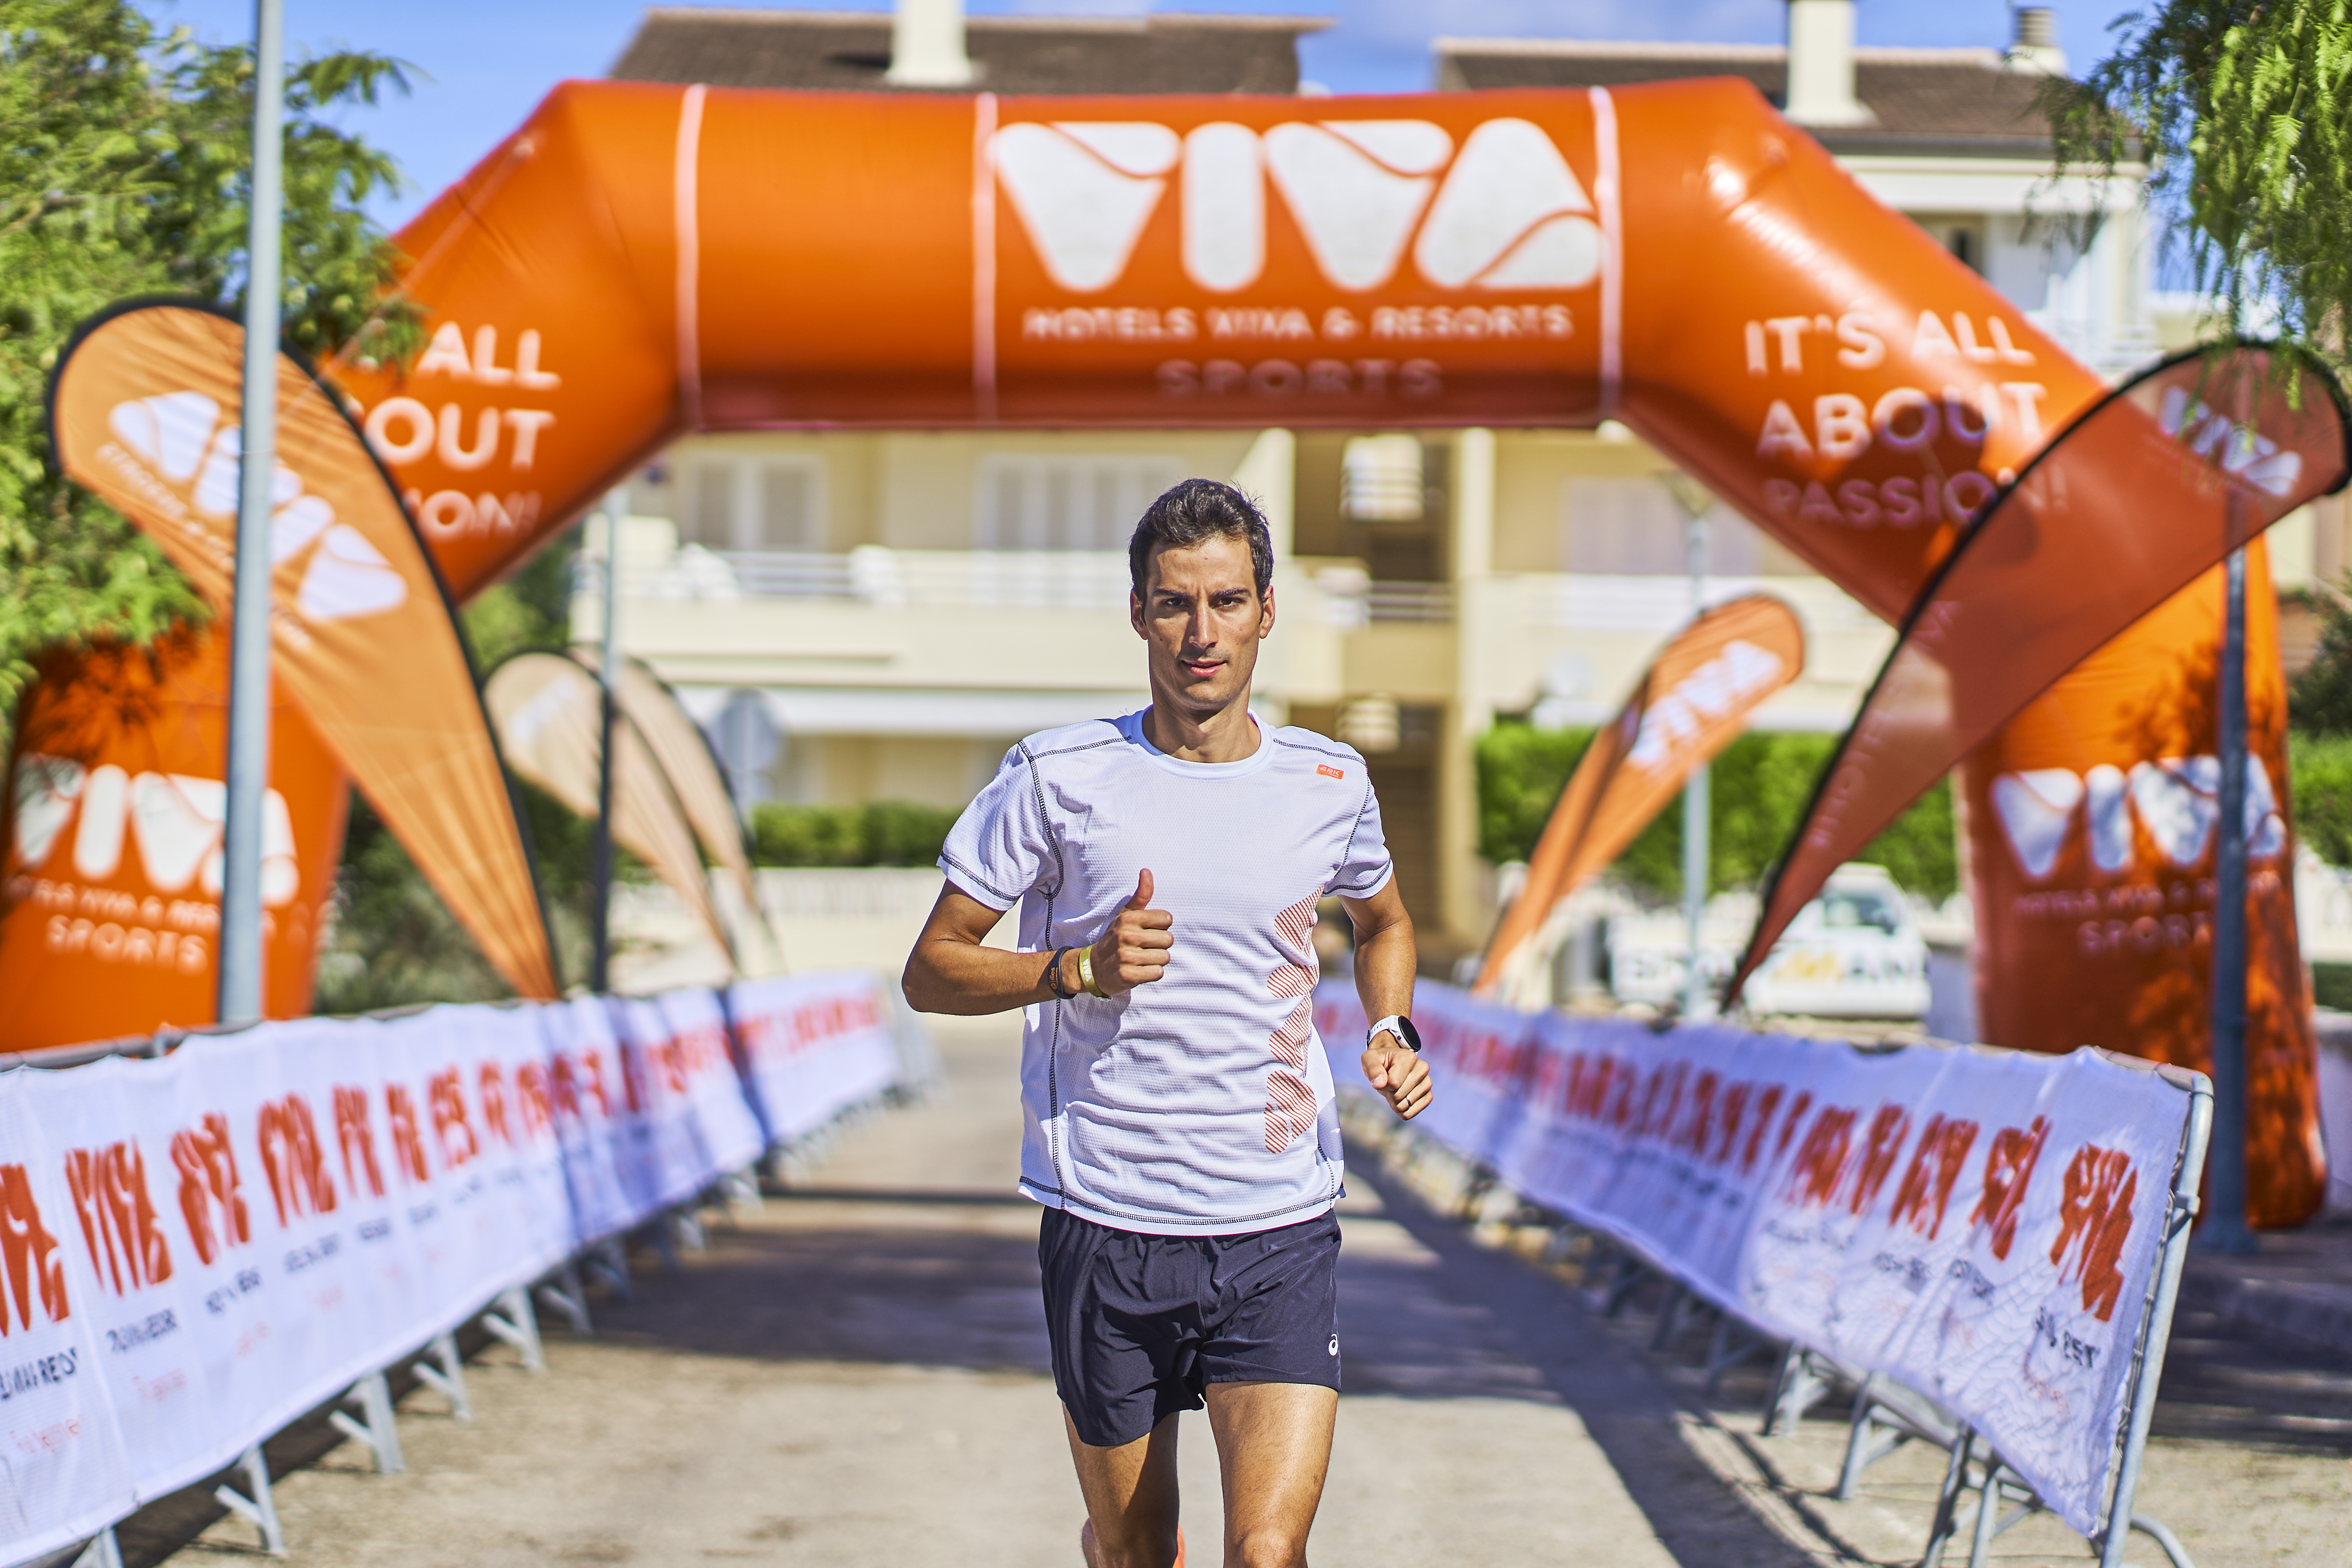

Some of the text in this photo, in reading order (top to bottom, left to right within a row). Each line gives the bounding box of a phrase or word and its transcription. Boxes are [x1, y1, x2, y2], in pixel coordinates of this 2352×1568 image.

[991, 118, 1606, 292] VIVA
[416, 321, 562, 391] ALL
[1022, 305, 1575, 342] HOTELS VIVA & RESORTS
[1745, 309, 2038, 377] IT'S ALL
[1156, 358, 1443, 399] SPORTS
[347, 395, 556, 472] OUT
[1756, 386, 2048, 460] ABOUT
[1320, 767, 1340, 776] 42K
[2078, 913, 2216, 955] SPORT
